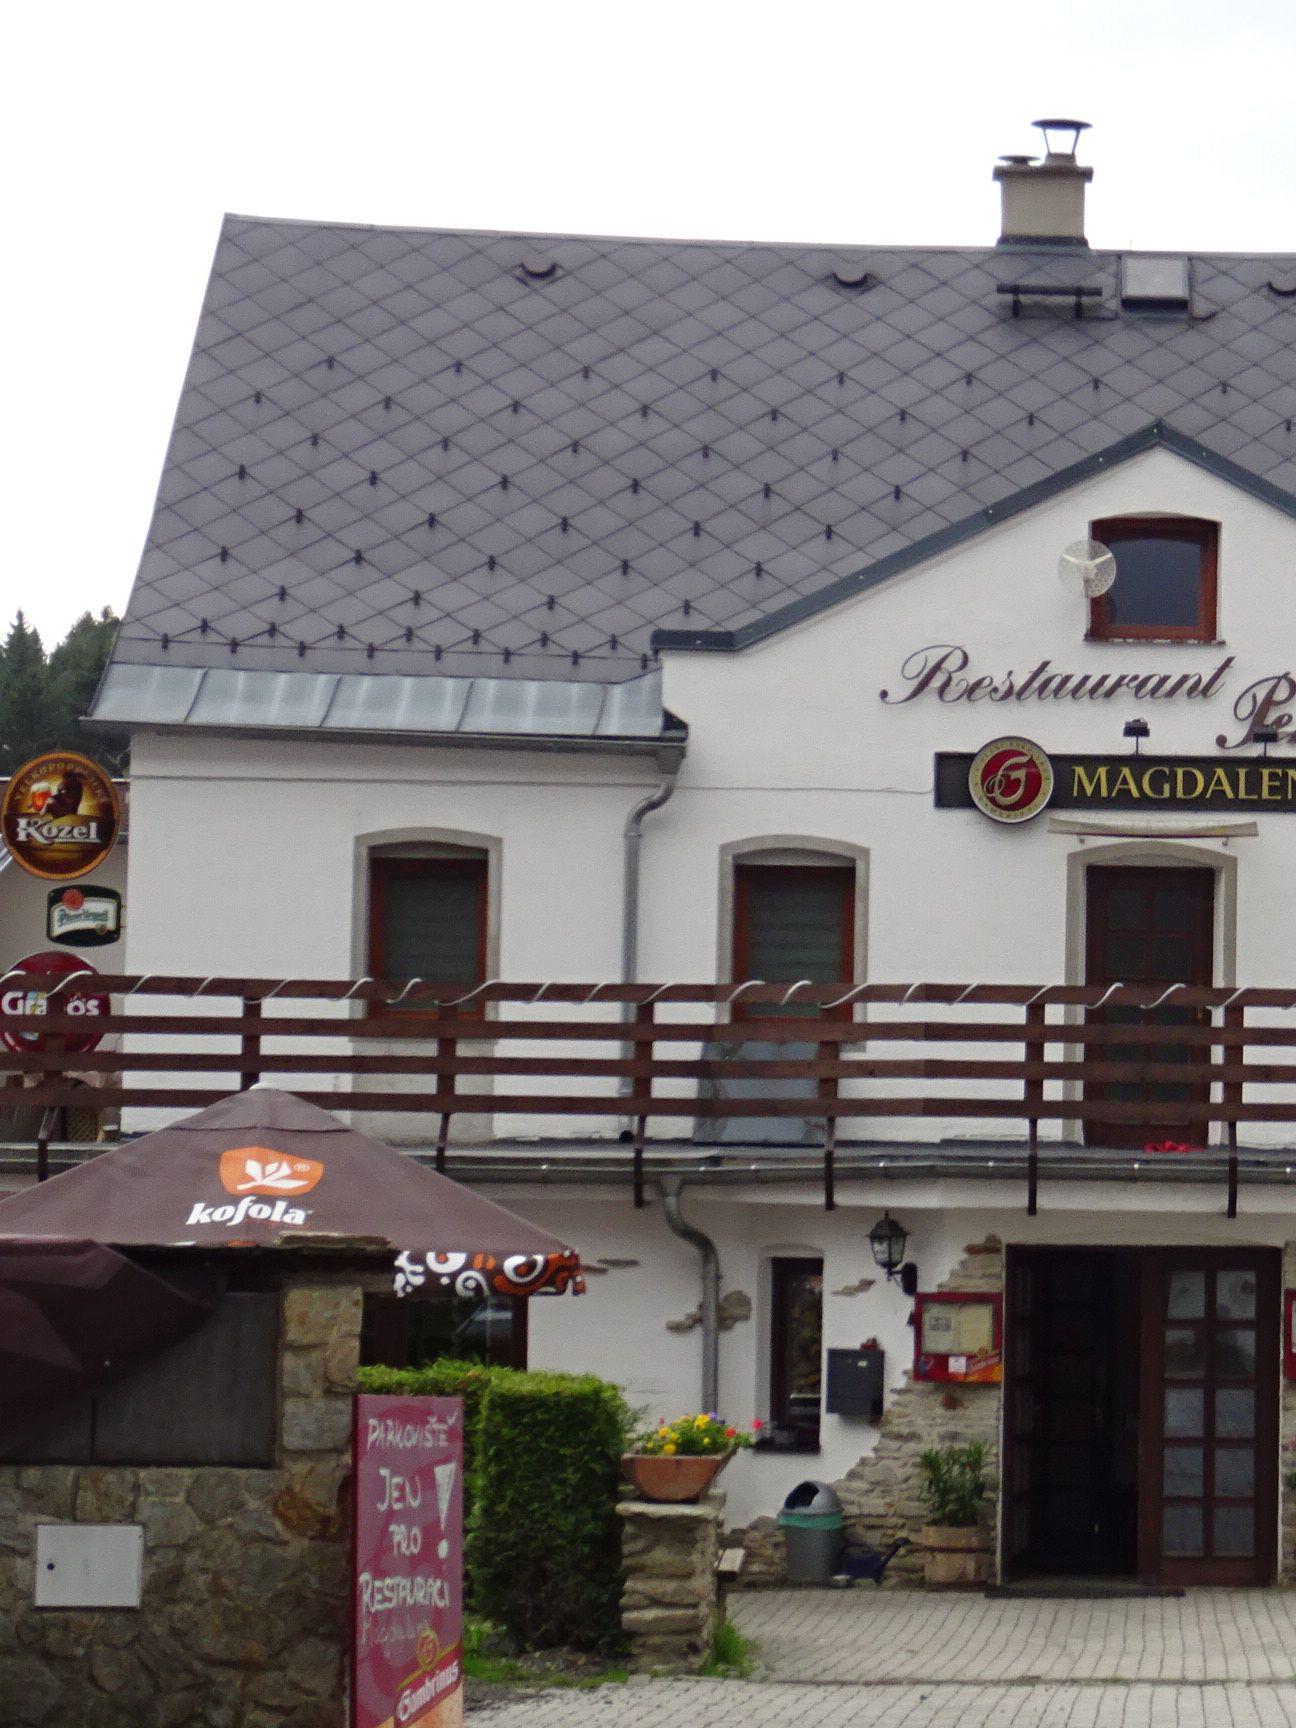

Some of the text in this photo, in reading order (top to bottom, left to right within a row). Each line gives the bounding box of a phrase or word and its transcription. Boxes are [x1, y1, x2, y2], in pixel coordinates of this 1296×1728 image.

[879, 644, 1237, 704] Restaurant
[16, 818, 102, 845] Kozel
[1, 990, 100, 1016] Graos
[185, 1195, 308, 1227] kofola
[388, 1524, 421, 1556] PRO
